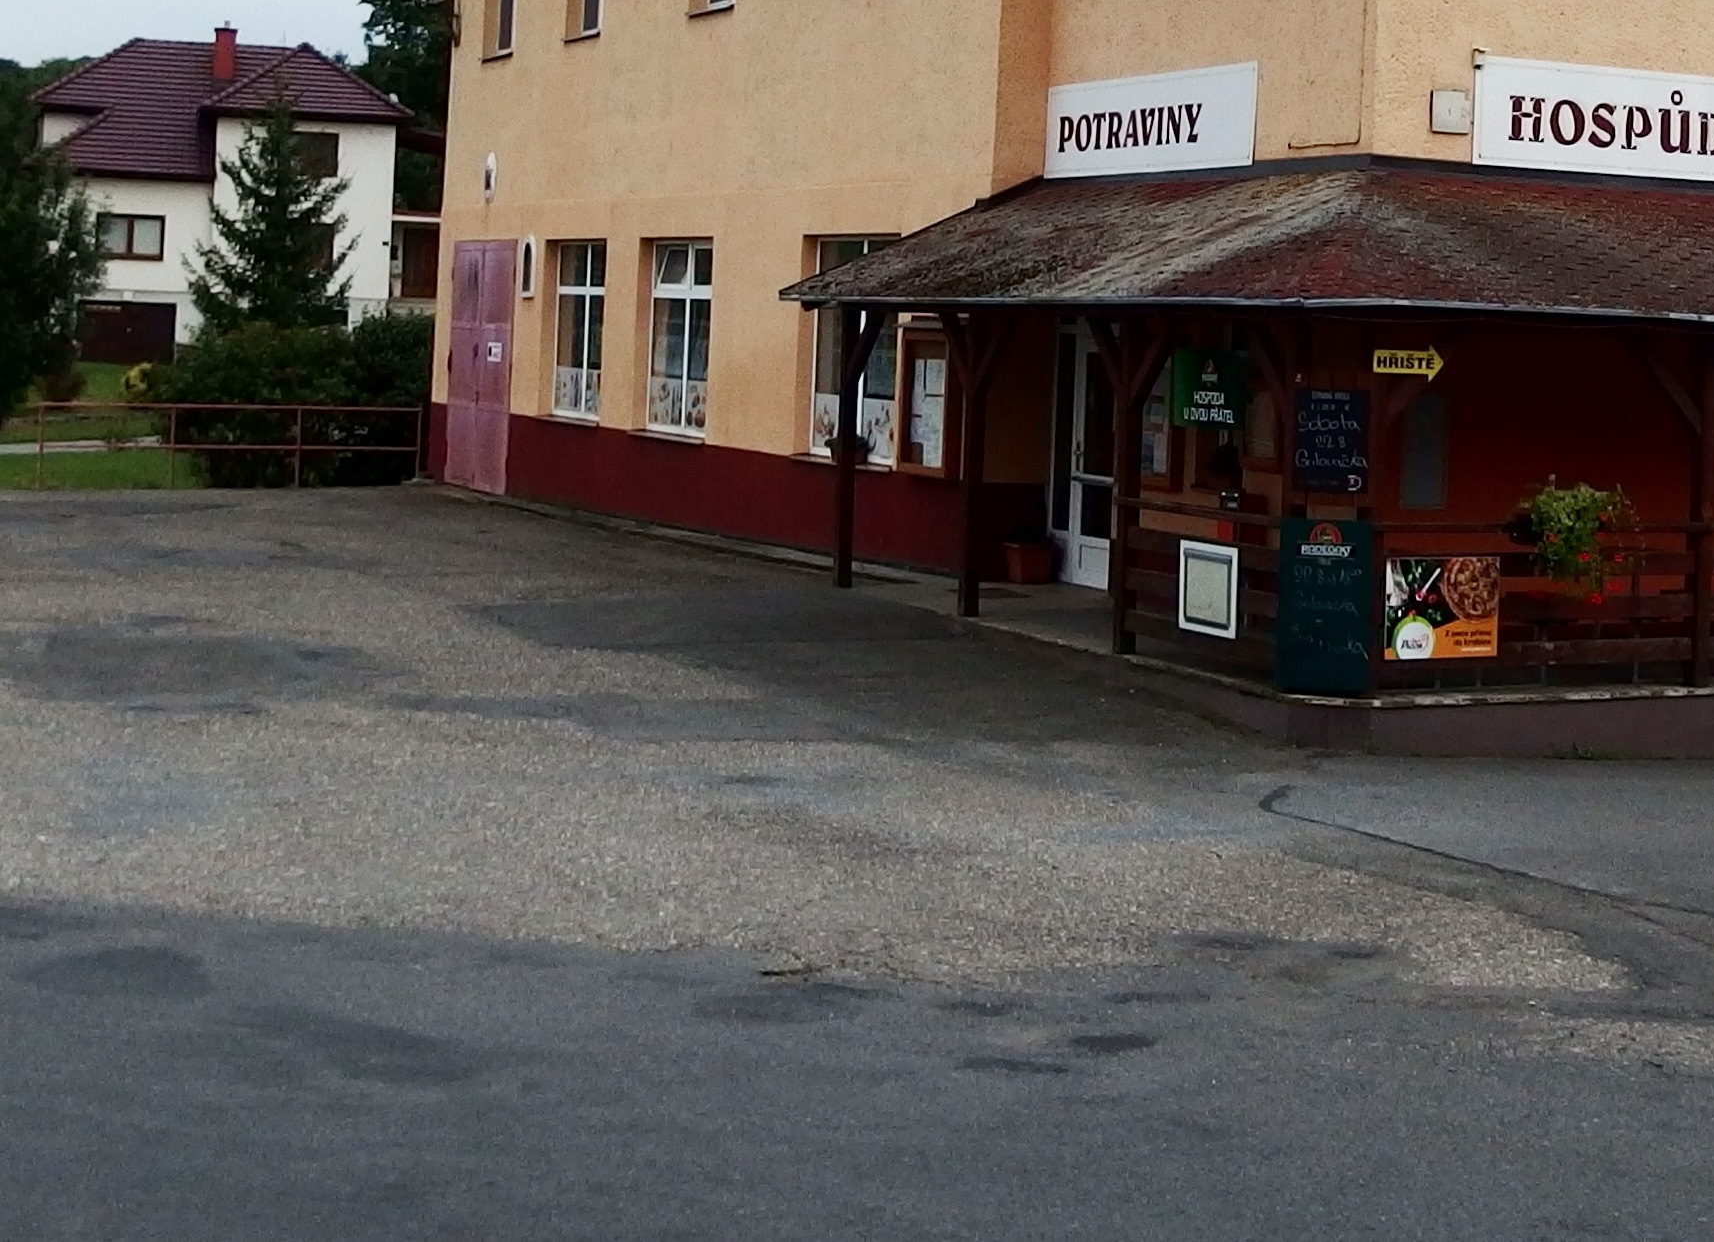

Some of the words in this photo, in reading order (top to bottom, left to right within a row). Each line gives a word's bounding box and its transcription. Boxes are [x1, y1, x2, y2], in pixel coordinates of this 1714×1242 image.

[1058, 103, 1203, 153] POTRAVINY
[1377, 351, 1435, 370] HŘIŠTĚ
[1193, 390, 1225, 405] HOSPODA
[1183, 407, 1190, 420] U
